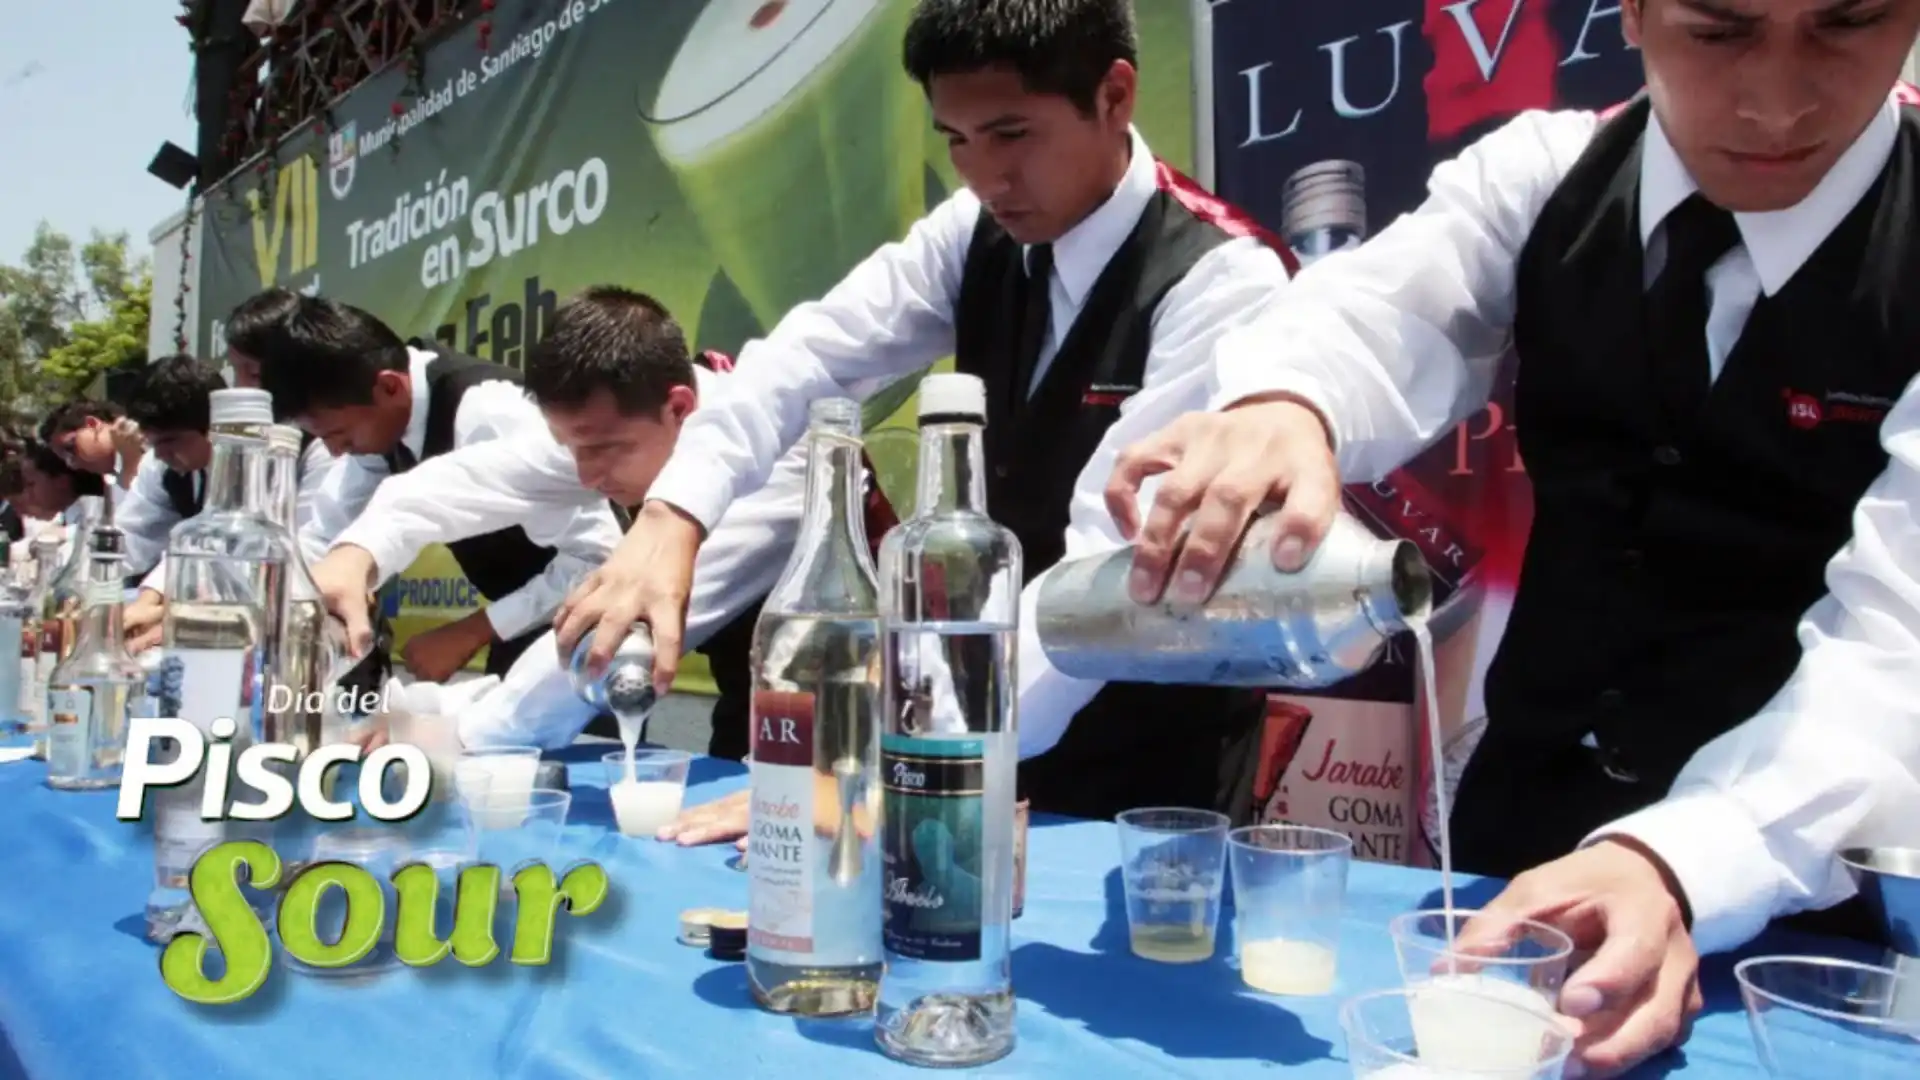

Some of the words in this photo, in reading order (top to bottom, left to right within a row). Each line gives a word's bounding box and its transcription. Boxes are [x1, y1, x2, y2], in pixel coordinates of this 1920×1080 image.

[456, 68, 477, 98] de
[480, 22, 557, 84] Santiago
[559, 0, 586, 30] de
[346, 168, 470, 270] Tradición
[420, 234, 461, 289] en
[466, 156, 609, 268] Surco
[1301, 738, 1404, 790] Jarabe
[1328, 796, 1404, 828] GOMA
